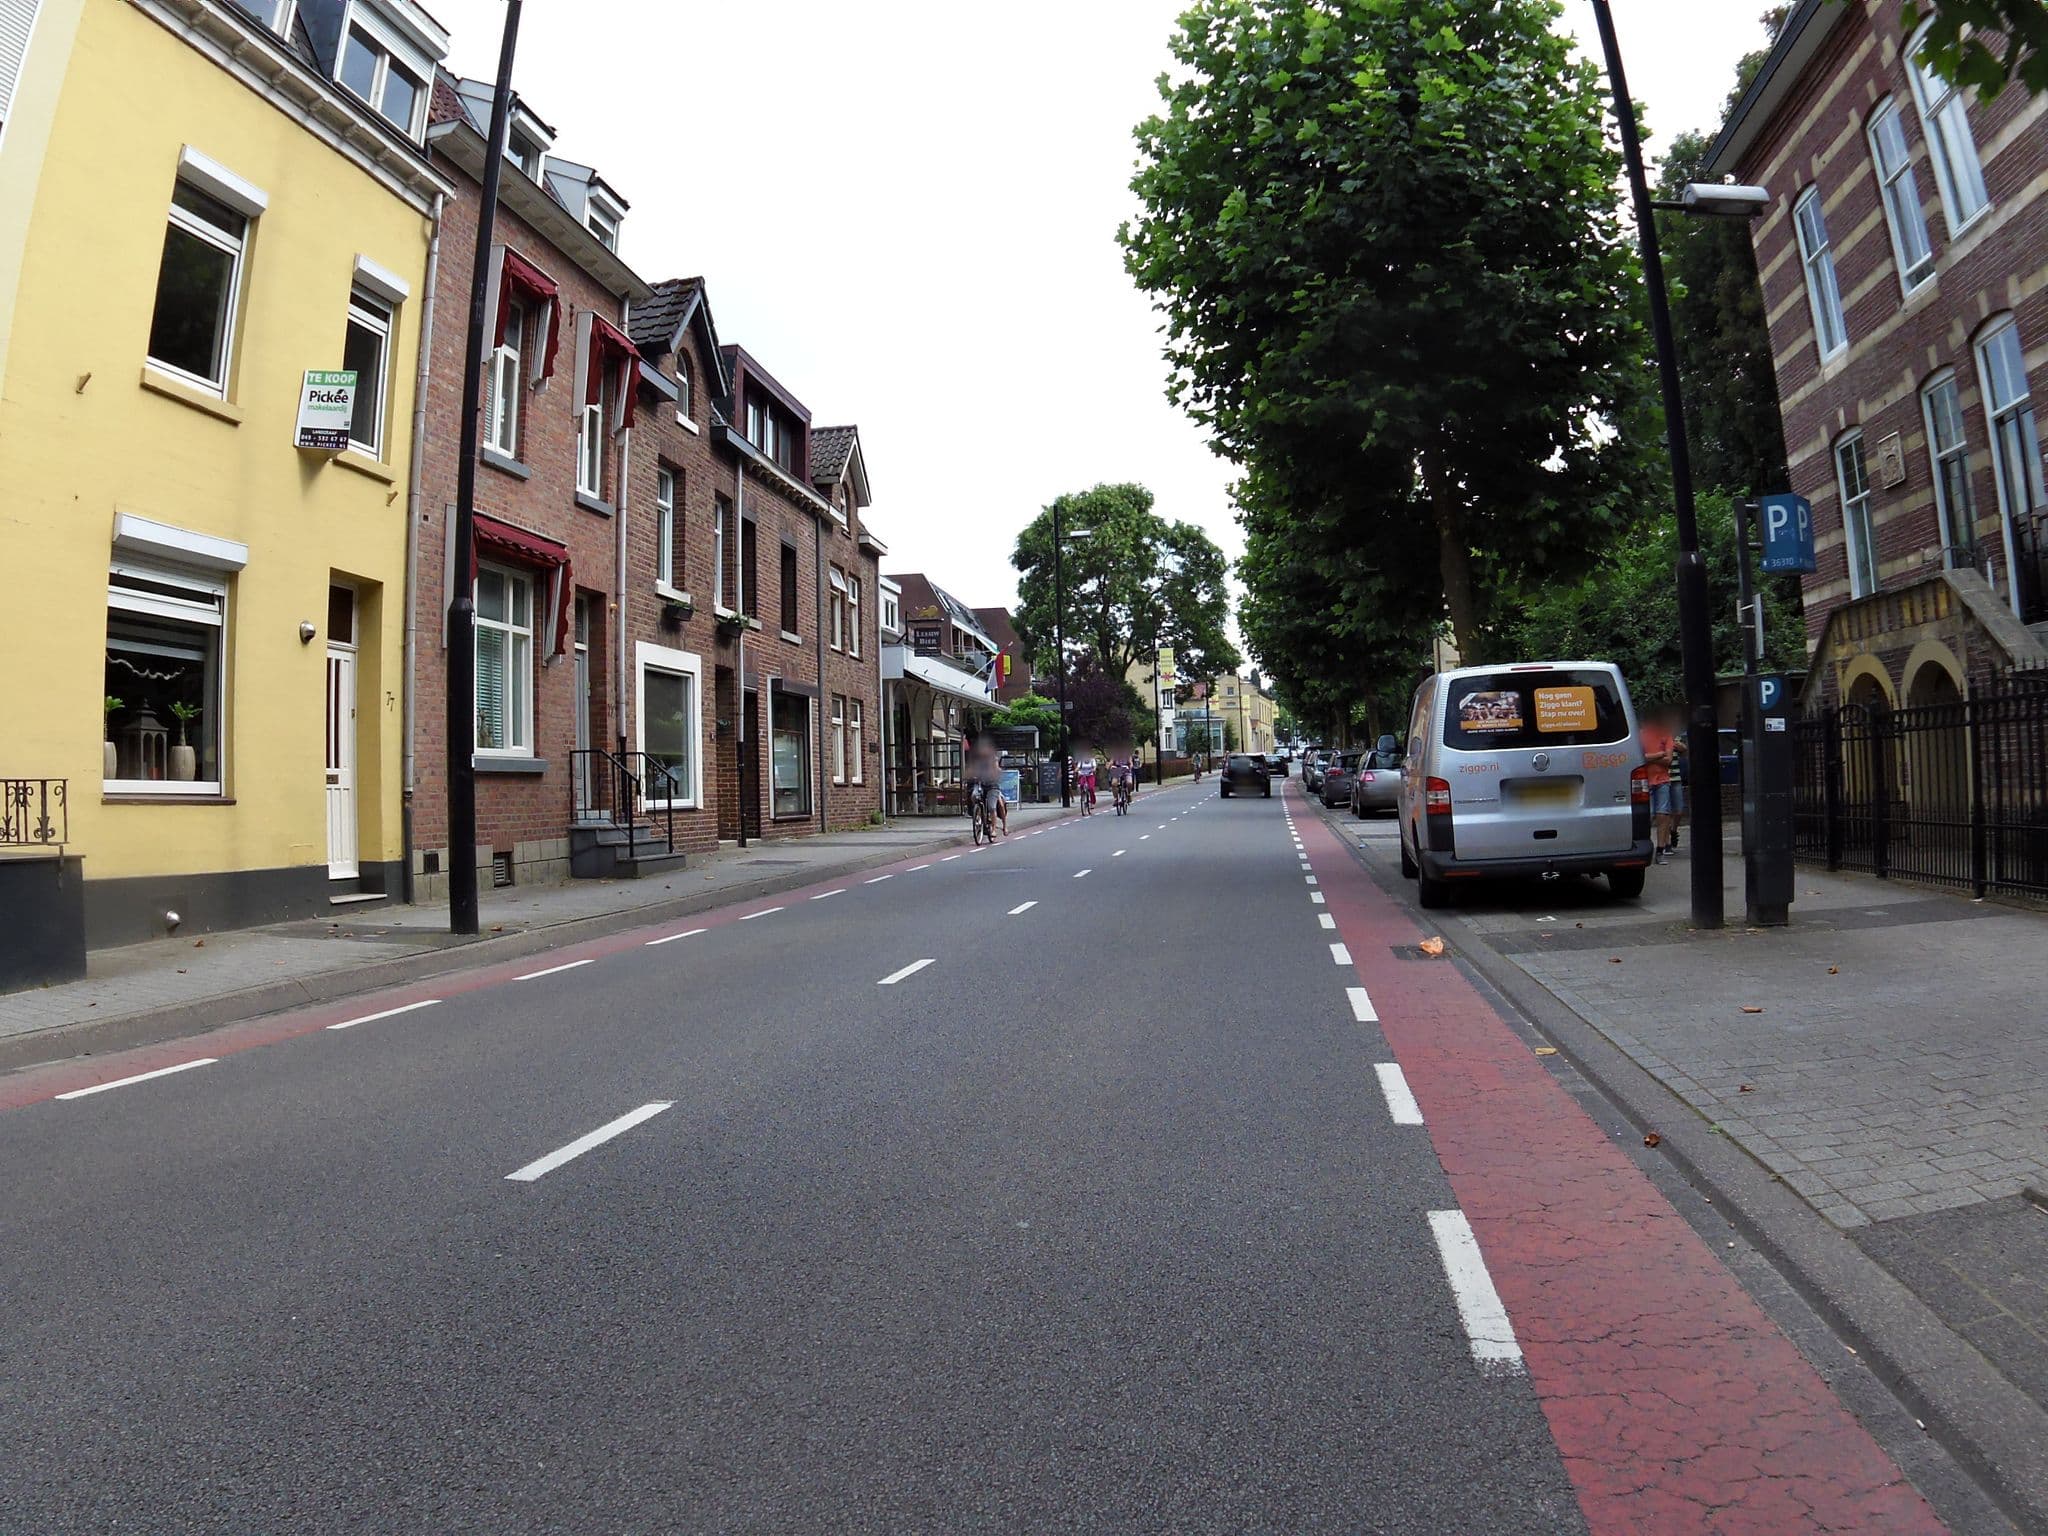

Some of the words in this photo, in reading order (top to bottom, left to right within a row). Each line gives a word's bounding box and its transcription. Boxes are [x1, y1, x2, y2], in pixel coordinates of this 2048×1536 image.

[308, 373, 322, 382] TE
[325, 374, 356, 384] KOOP
[1767, 505, 1788, 543] P
[1797, 504, 1808, 542] P
[1761, 681, 1775, 704] P
[1540, 701, 1561, 709] Ziggo
[1459, 762, 1499, 774] ziggo.nl
